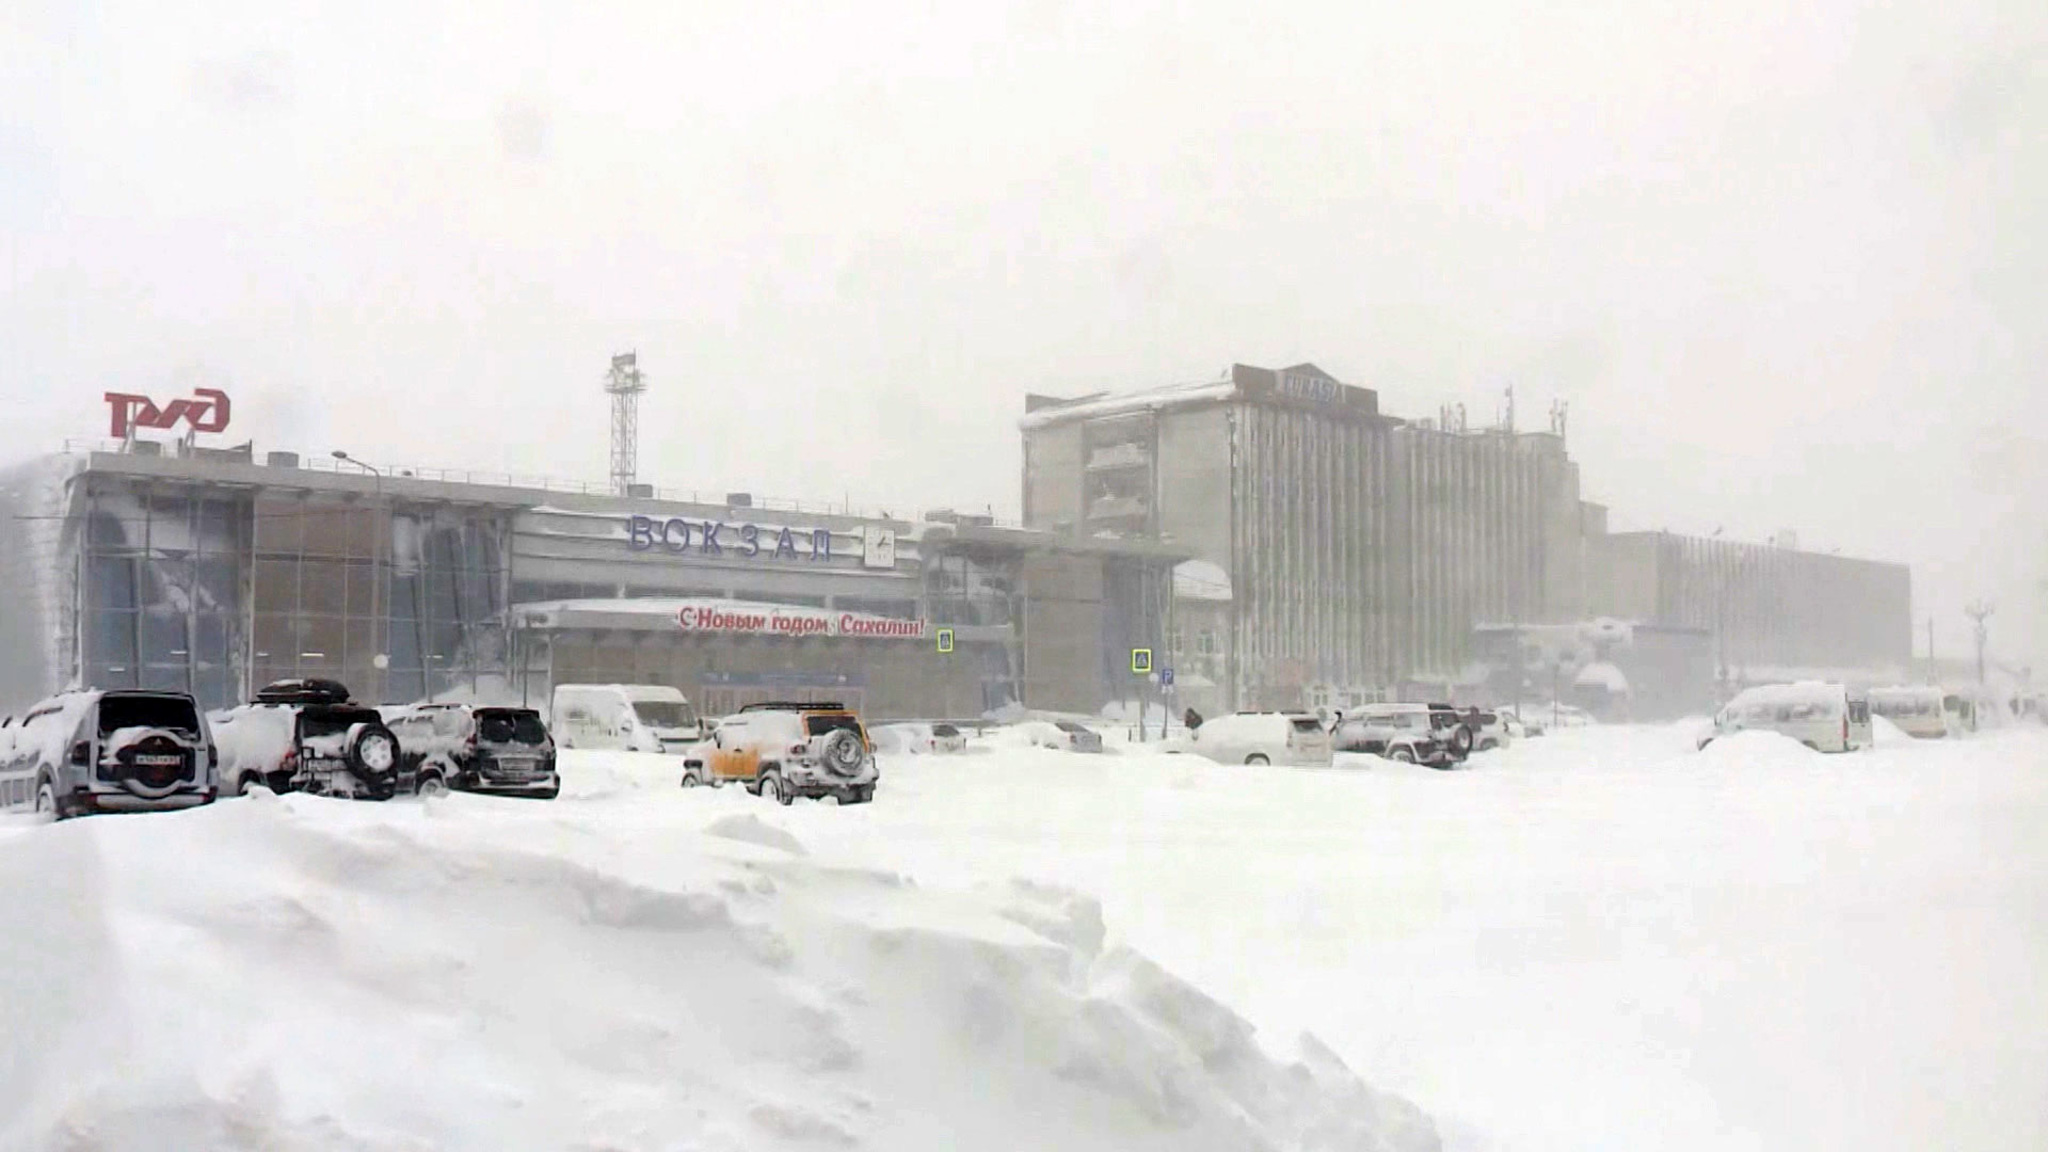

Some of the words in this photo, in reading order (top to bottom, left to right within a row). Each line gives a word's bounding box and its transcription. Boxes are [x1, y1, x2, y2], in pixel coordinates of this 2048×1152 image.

[629, 515, 830, 560] ВОКЗАЛ
[697, 609, 765, 629] Новым
[840, 614, 926, 637] Сахалин!
